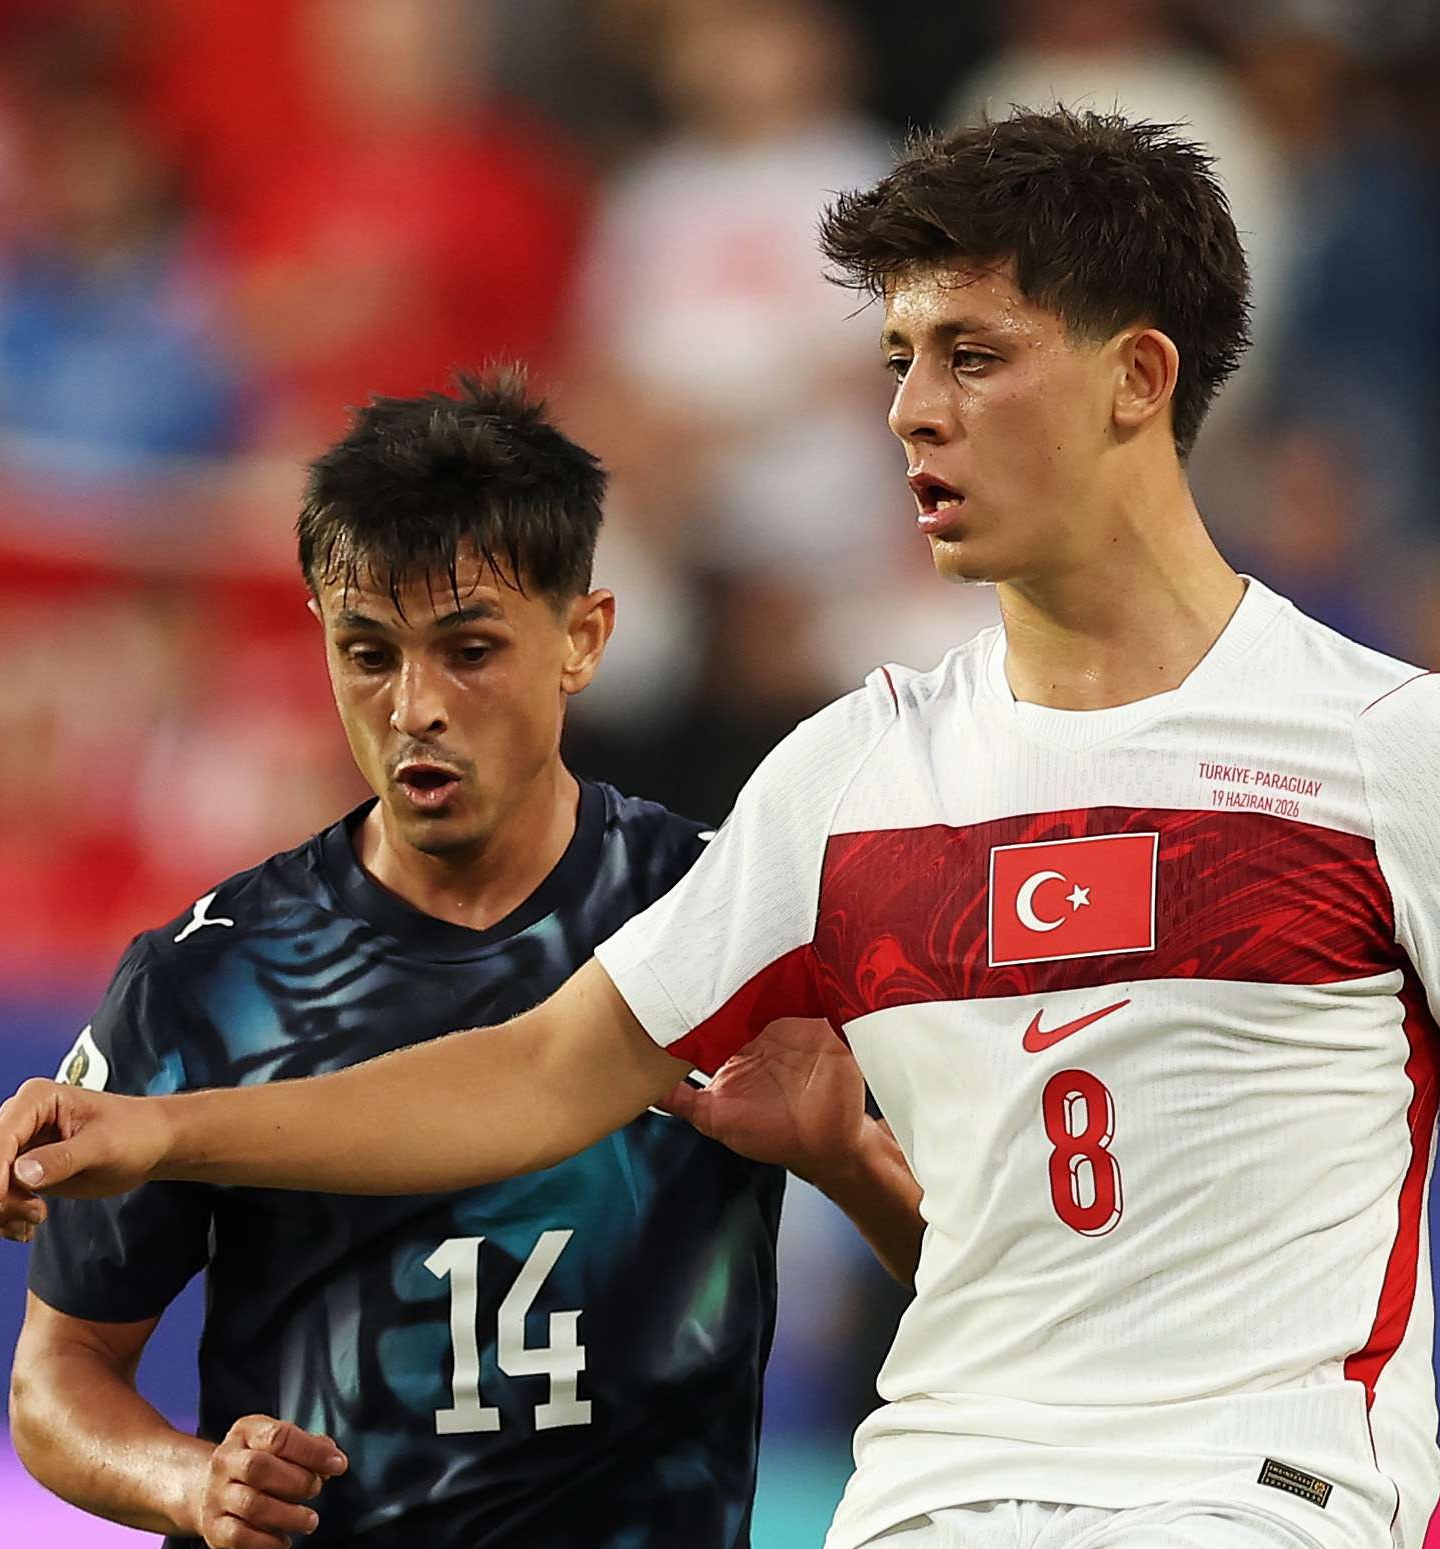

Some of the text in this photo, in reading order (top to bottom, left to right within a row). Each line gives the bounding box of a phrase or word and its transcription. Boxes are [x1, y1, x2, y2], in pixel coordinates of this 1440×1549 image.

[1199, 761, 1322, 797] TÜRKİYE-PARAGUAY
[1212, 789, 1300, 818] 19 HAZİRAN 2026
[1041, 1069, 1125, 1237] 8
[423, 1229, 592, 1434] 14
